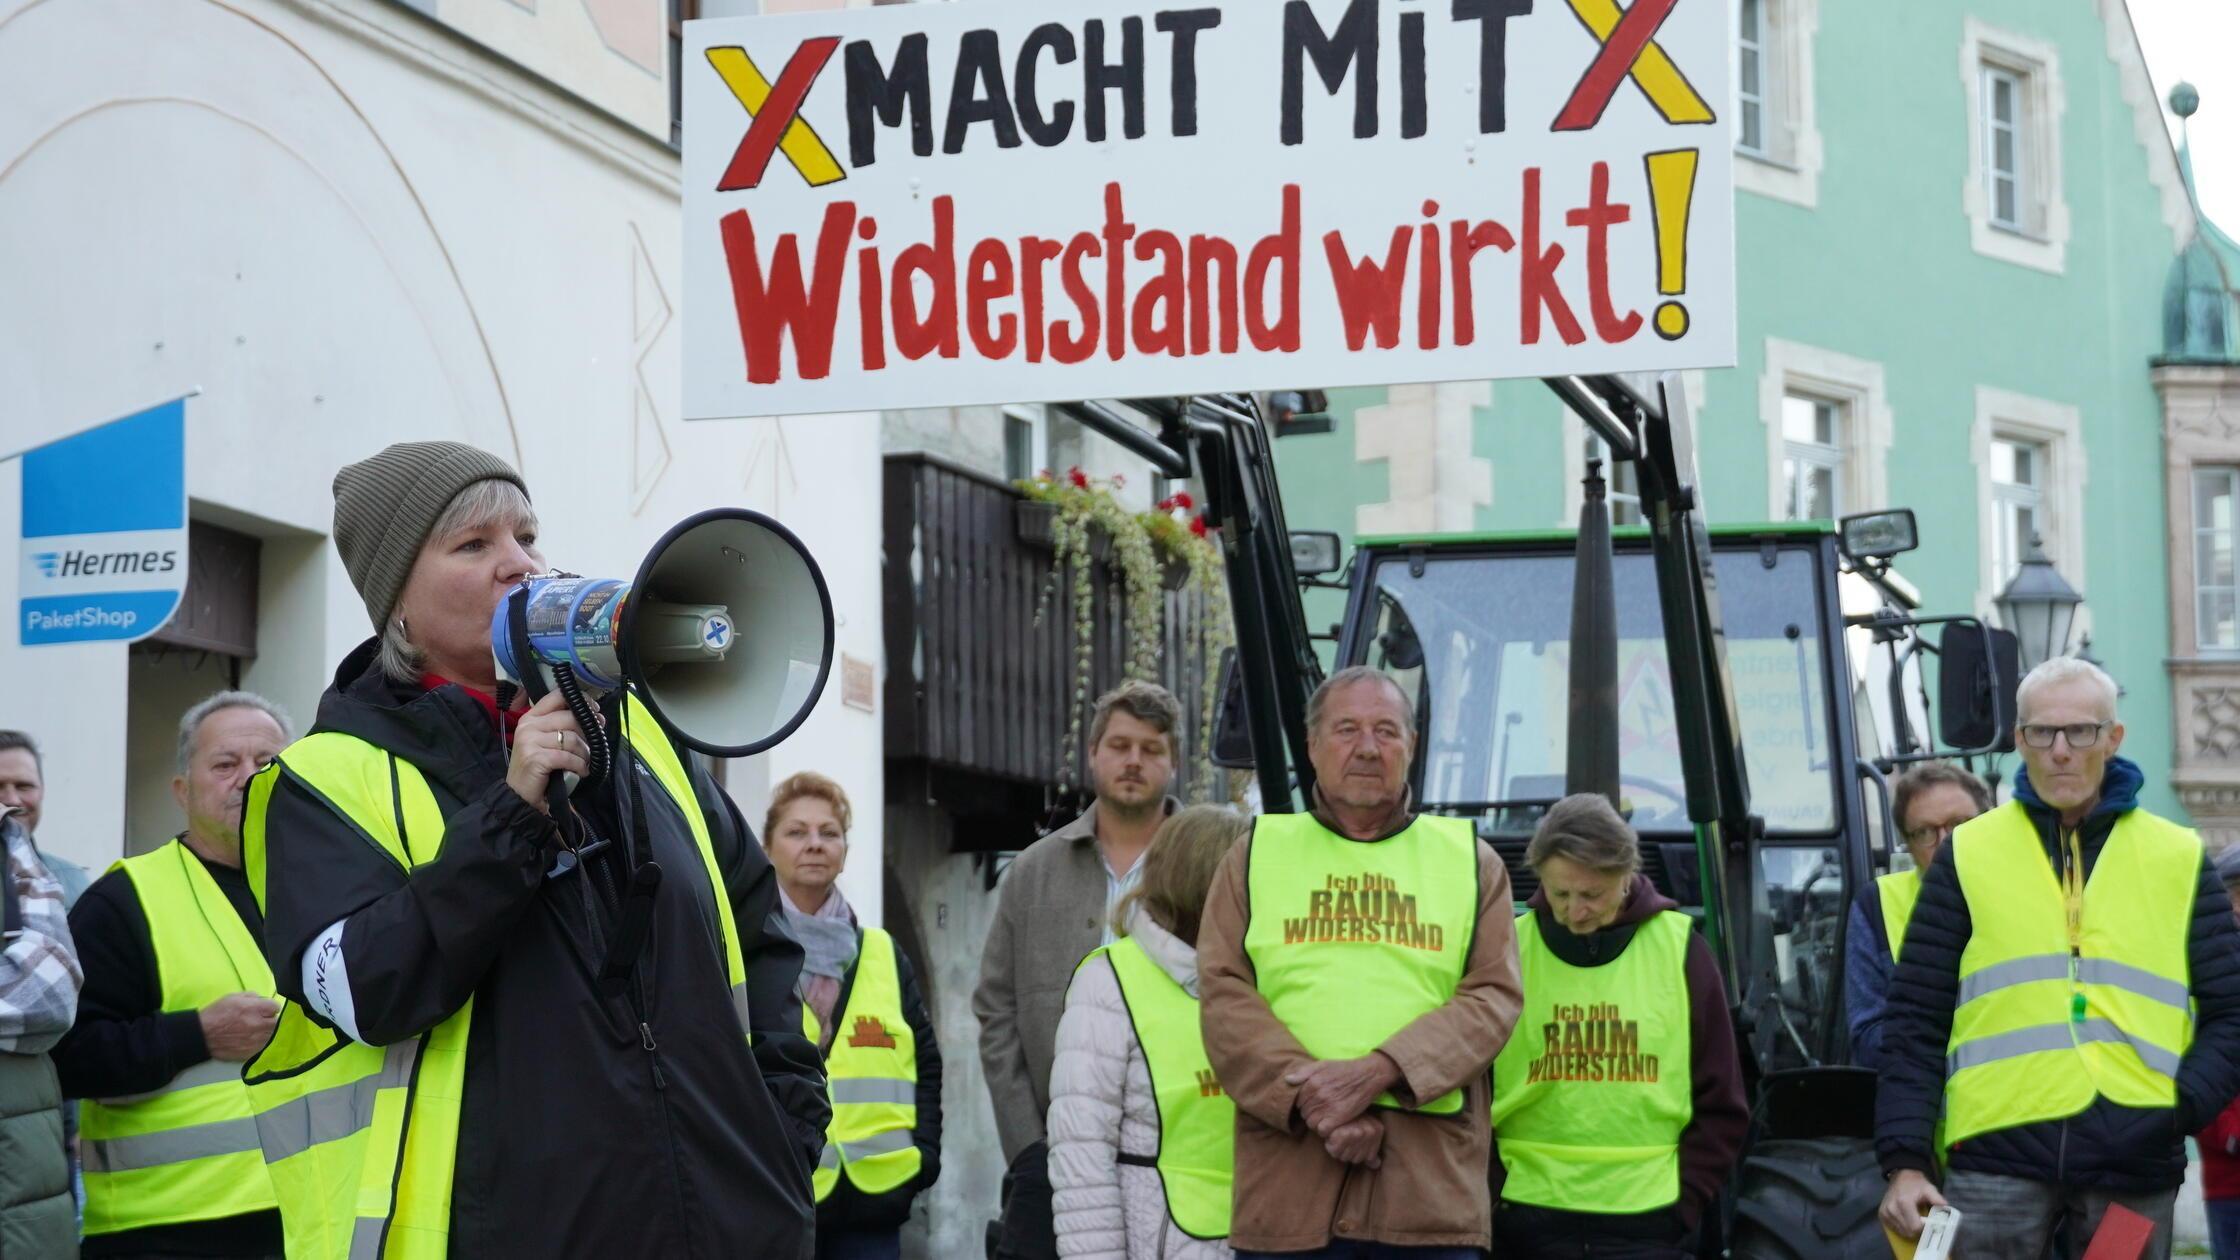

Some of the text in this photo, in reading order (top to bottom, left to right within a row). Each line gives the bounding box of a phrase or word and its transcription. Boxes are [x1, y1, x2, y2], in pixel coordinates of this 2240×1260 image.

[846, 10, 1222, 167] MACHT
[719, 184, 1303, 384] Widerstand
[61, 550, 177, 577] Hermes
[27, 607, 137, 630] PaketShop
[1326, 872, 1396, 891] Ich bin
[1309, 890, 1418, 922] RAUM
[1284, 918, 1443, 951] WIDERSTAND
[1553, 1003, 1584, 1021] Ich
[1543, 1020, 1638, 1055] RAUM
[1527, 1053, 1658, 1085] WIDERSTAND
